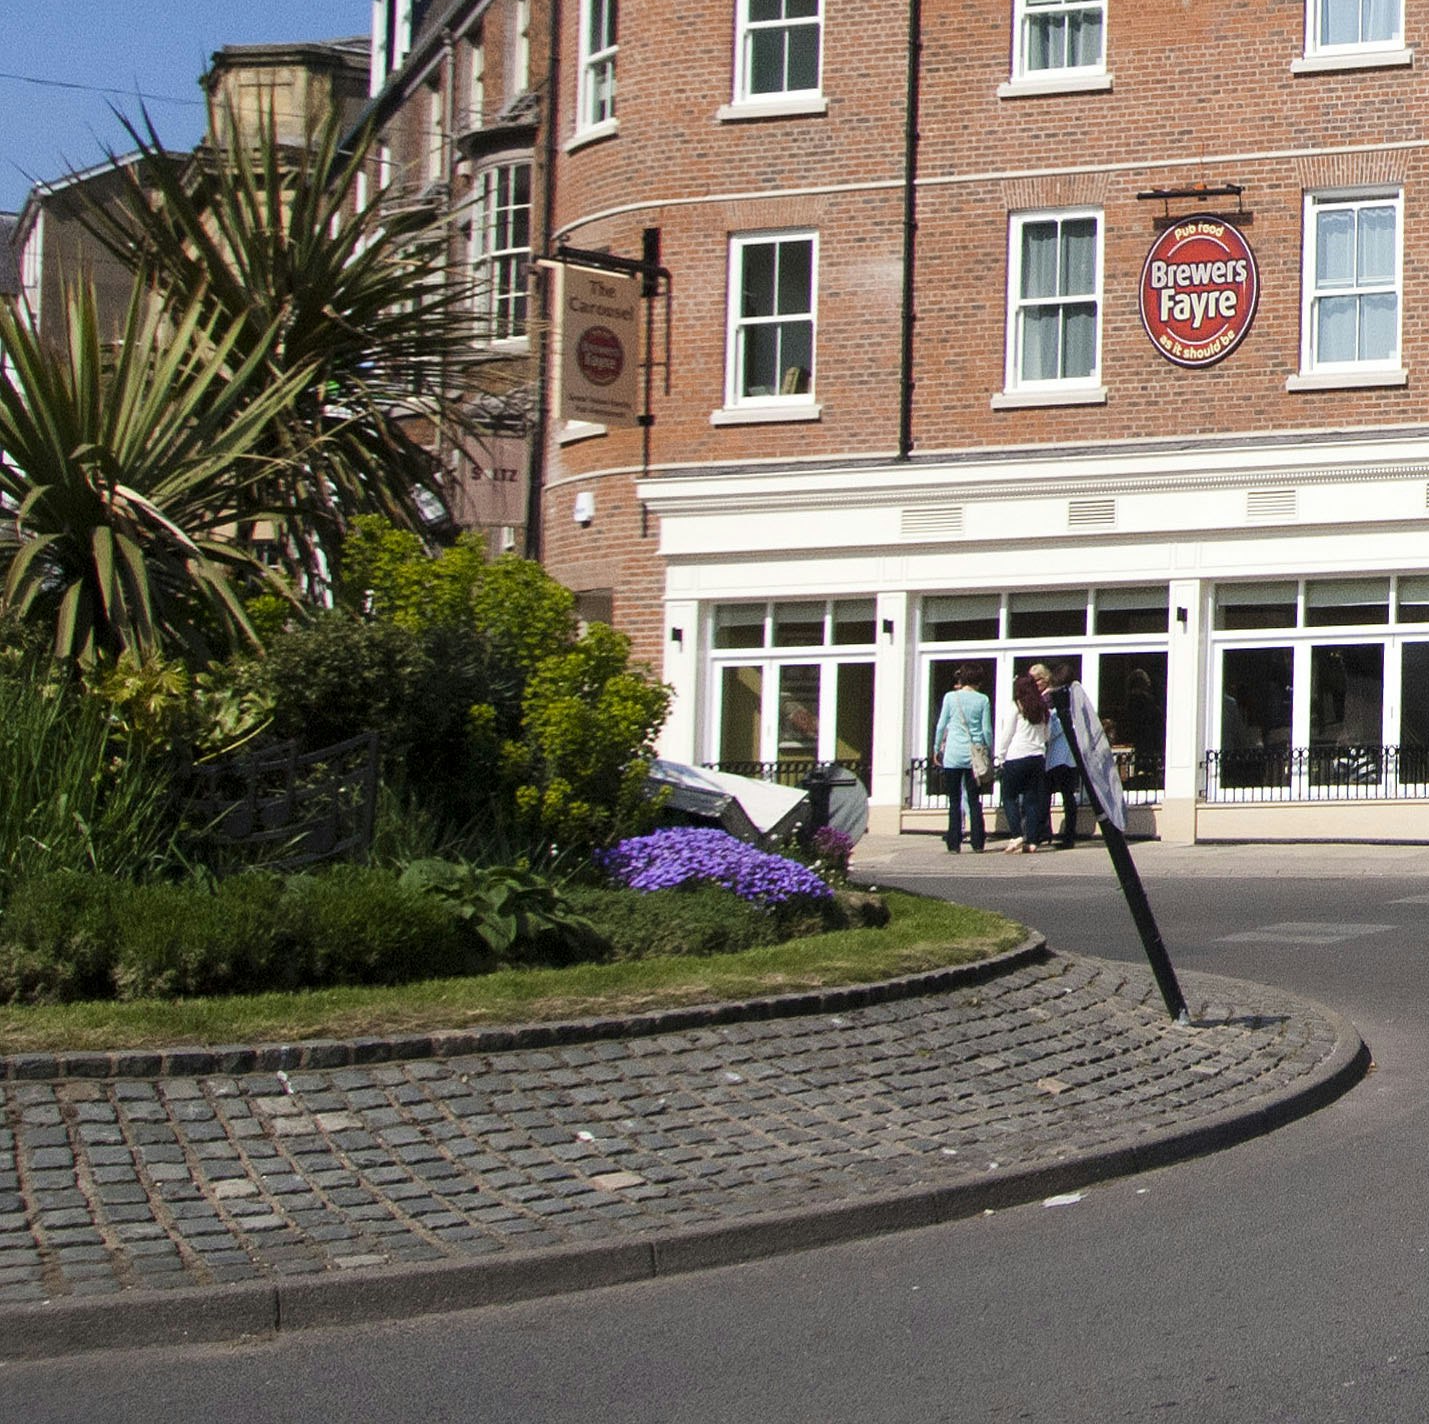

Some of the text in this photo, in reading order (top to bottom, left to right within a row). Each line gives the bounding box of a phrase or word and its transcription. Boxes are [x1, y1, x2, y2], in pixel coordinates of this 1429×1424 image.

[1174, 224, 1196, 240] Pub
[1151, 260, 1248, 288] Brewers
[588, 280, 617, 298] The
[1160, 288, 1237, 328] Fayre
[1159, 329, 1235, 359] as it should be
